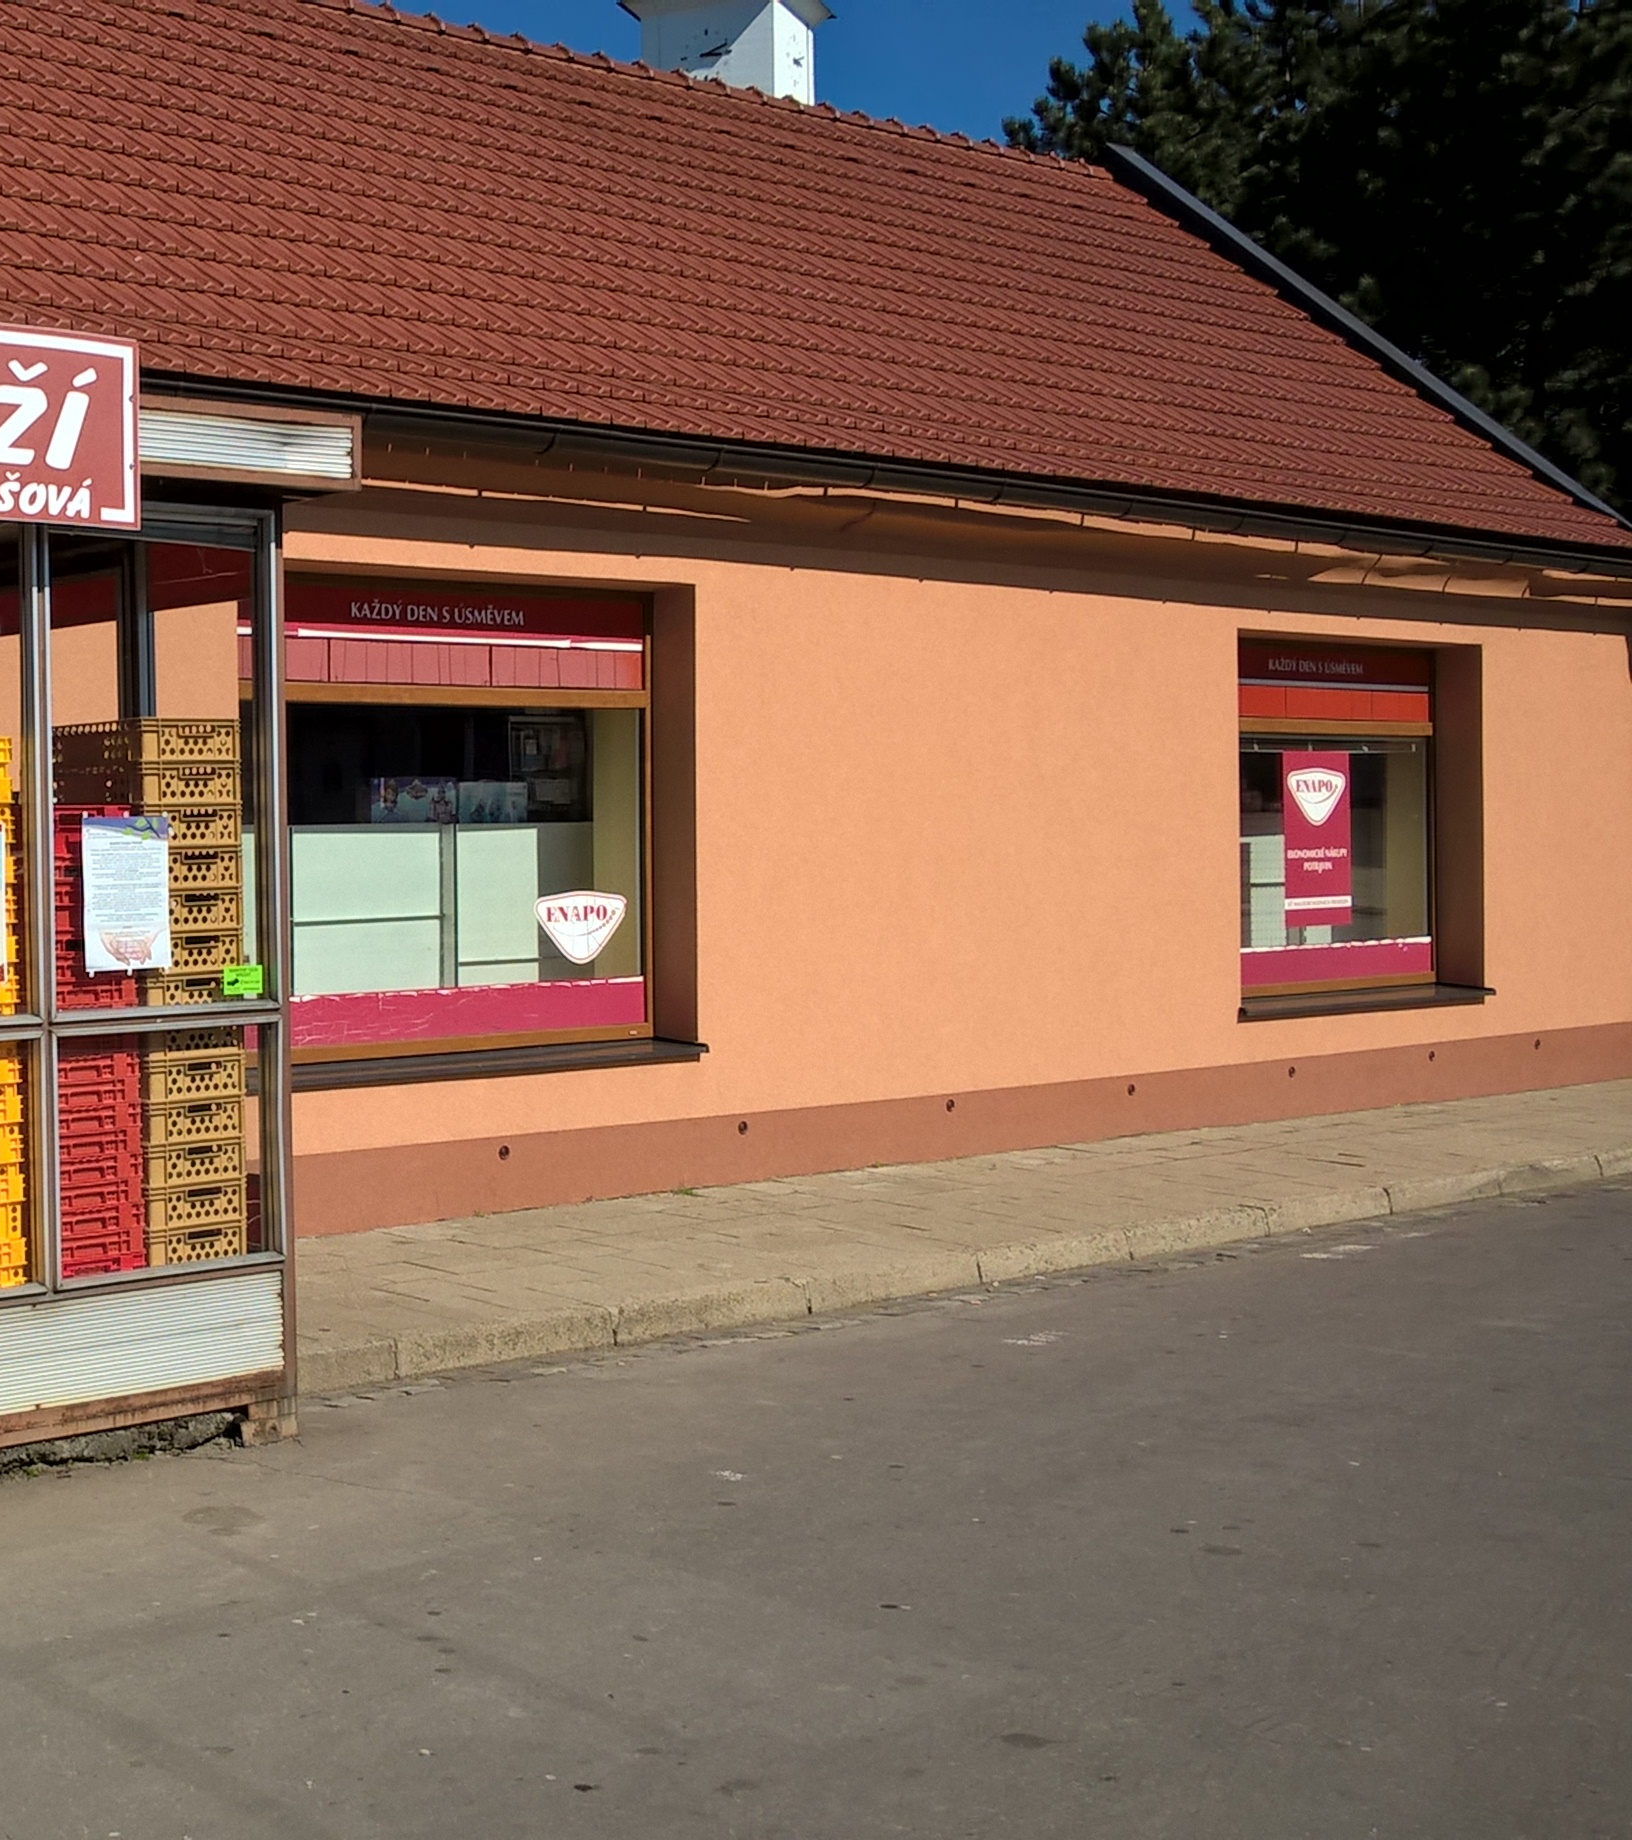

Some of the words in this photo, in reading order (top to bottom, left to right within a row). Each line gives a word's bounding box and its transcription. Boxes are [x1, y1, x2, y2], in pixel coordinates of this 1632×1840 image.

[351, 599, 402, 620] KAŽDÝ
[407, 605, 438, 621] DEN
[442, 606, 450, 623] S
[454, 602, 524, 626] ÚSMĚVEM
[1296, 778, 1333, 793] ENAPO
[546, 905, 607, 922] ENAPO
